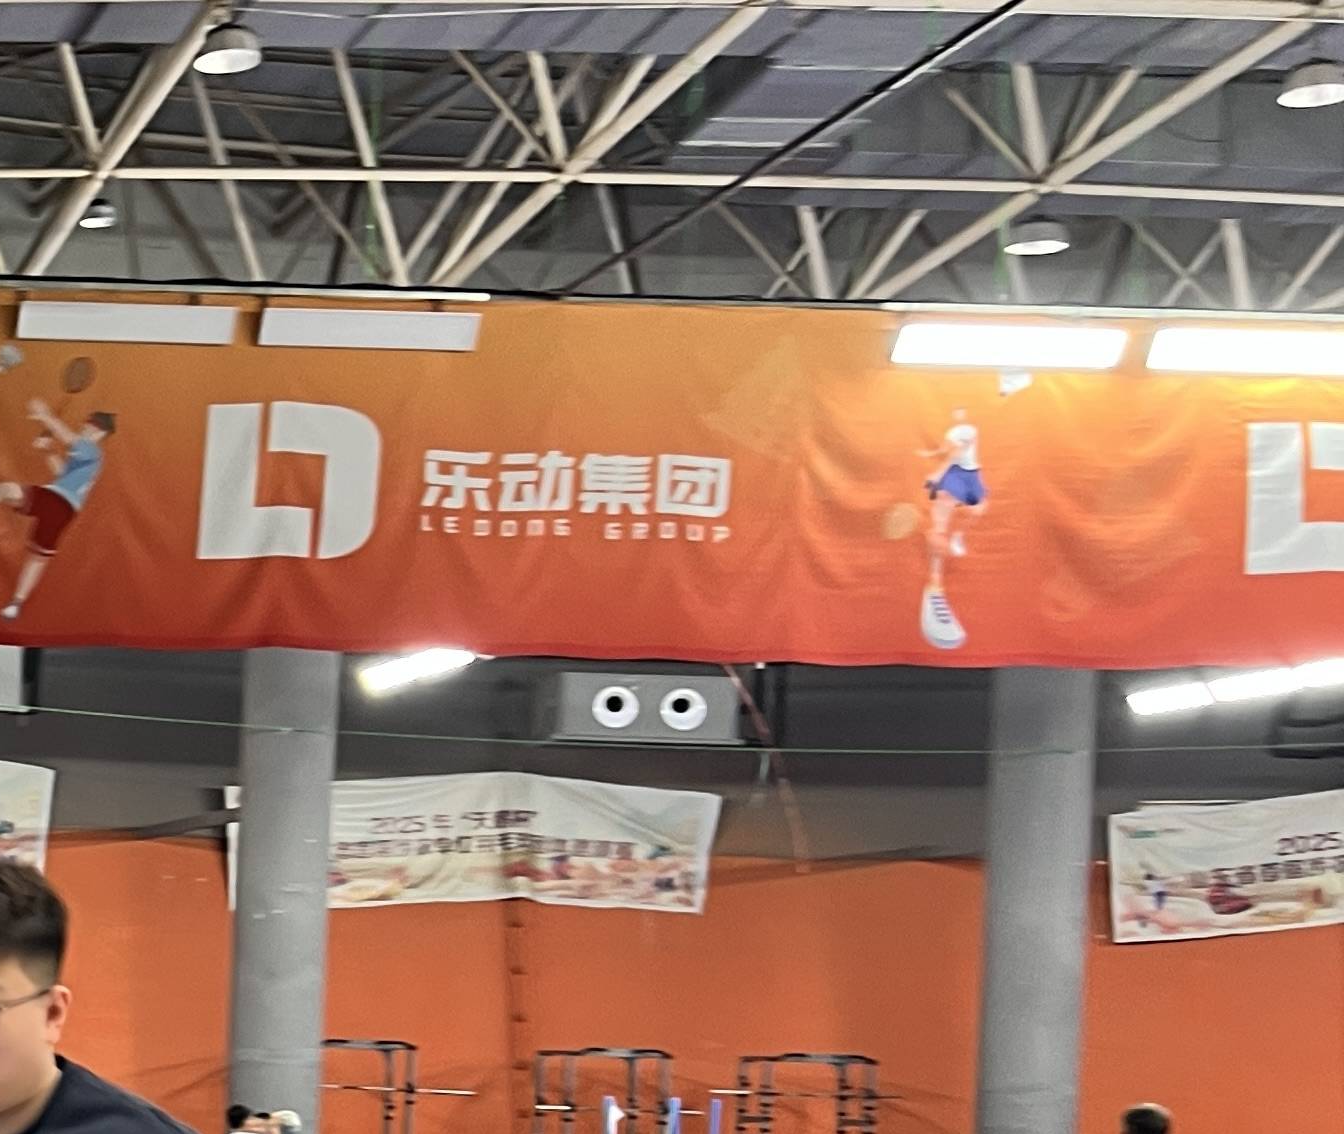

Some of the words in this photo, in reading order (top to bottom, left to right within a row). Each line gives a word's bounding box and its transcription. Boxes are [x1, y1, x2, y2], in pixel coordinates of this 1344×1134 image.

[419, 449, 731, 517] 乐动集团
[603, 521, 731, 543] GROUP
